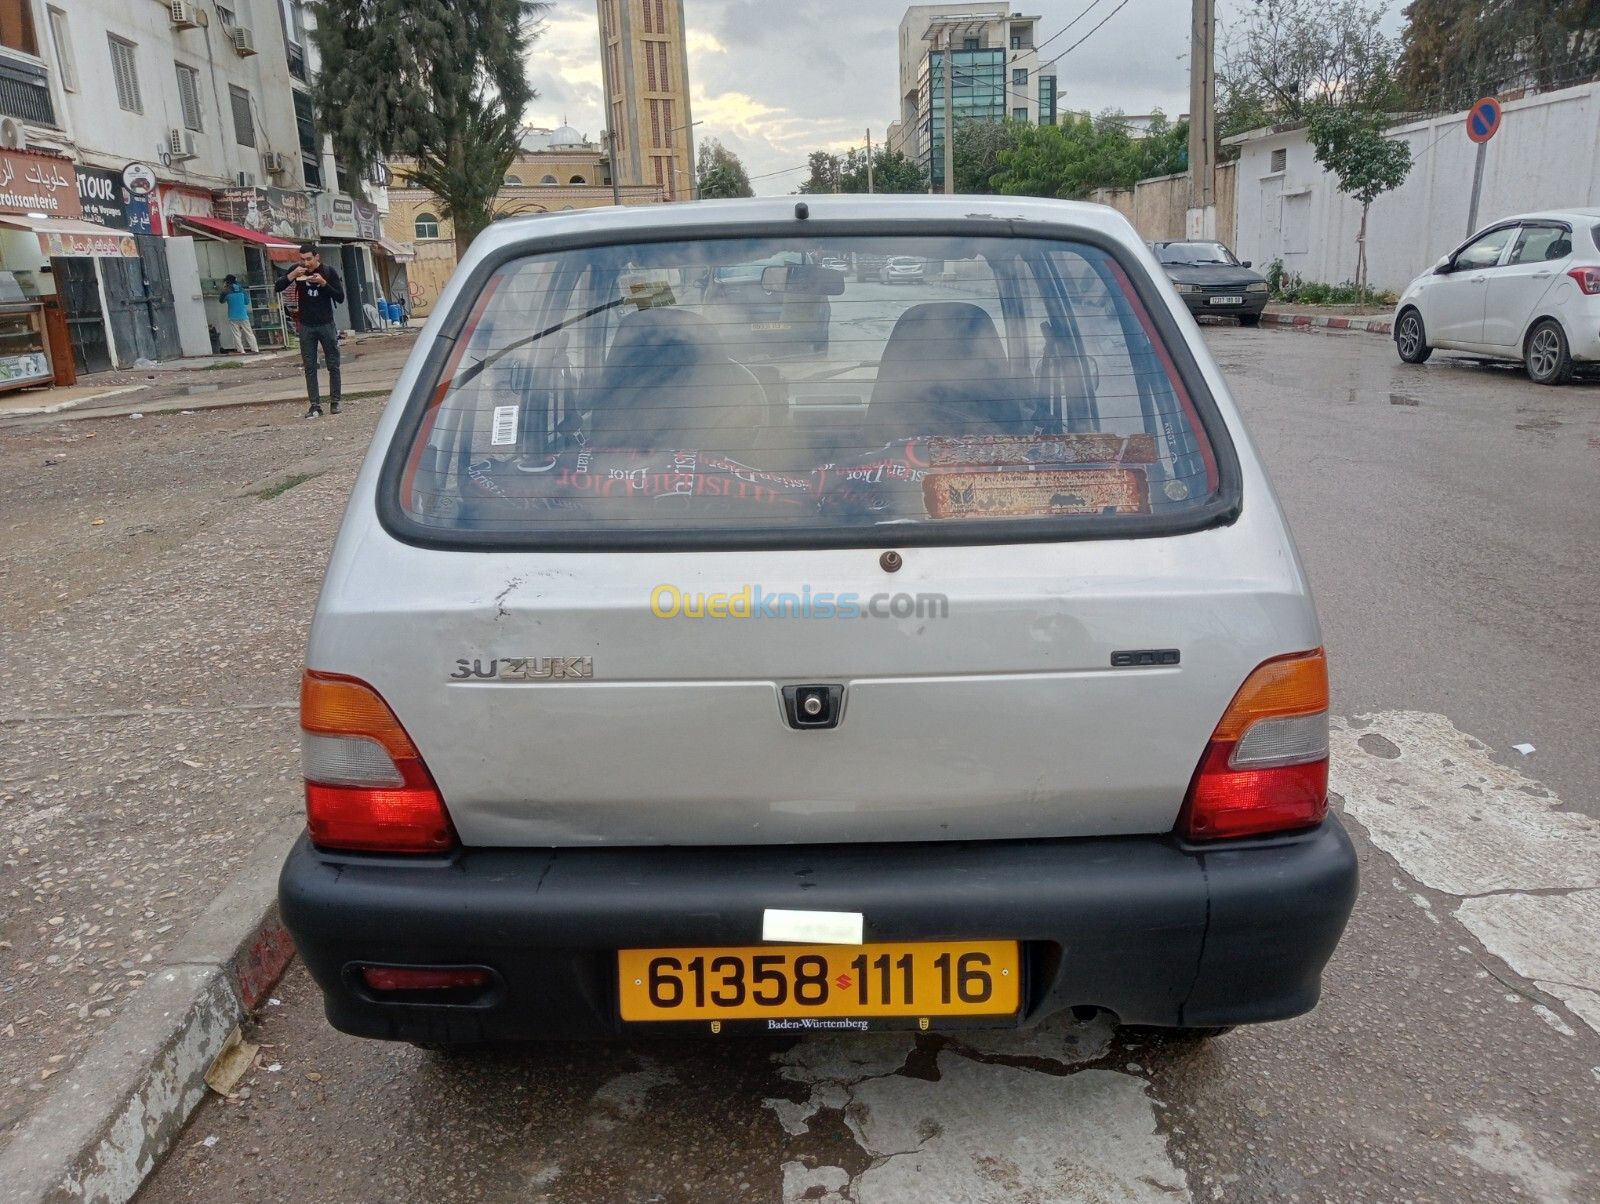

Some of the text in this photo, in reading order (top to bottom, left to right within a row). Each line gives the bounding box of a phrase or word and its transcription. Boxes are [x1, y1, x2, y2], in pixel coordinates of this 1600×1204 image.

[25, 163, 69, 192] حلويات
[0, 190, 58, 210] roissanterie
[450, 656, 593, 679] SUZUKI
[647, 952, 992, 1008] 61358 111 16
[767, 1018, 868, 1032] Baden-Württemberg
